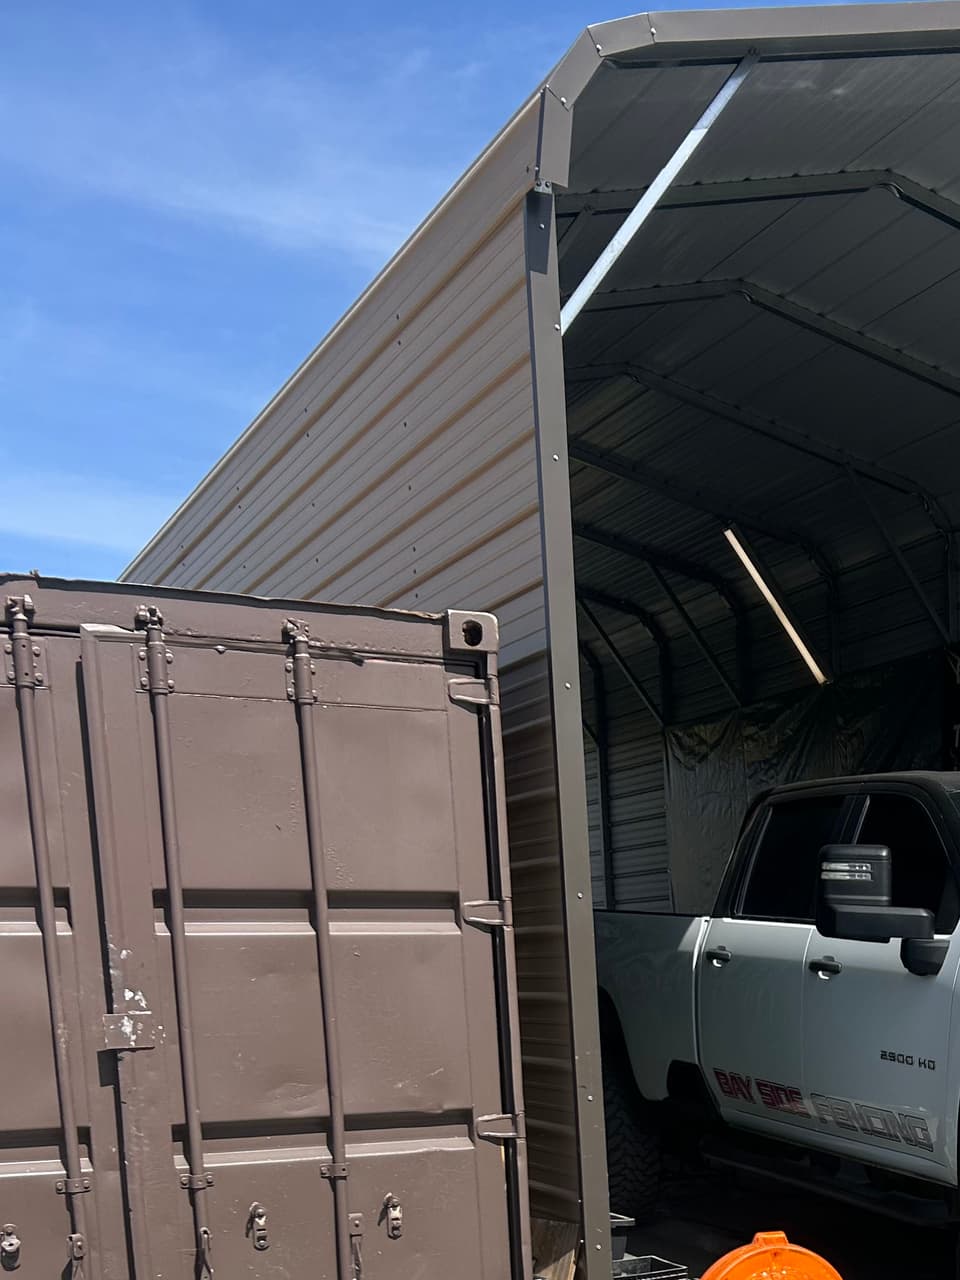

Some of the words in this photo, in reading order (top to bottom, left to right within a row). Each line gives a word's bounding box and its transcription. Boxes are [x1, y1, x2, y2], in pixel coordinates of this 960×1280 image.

[713, 1067, 756, 1104] BAY
[755, 1078, 811, 1119] SIDE
[809, 1092, 934, 1153] FENCING
